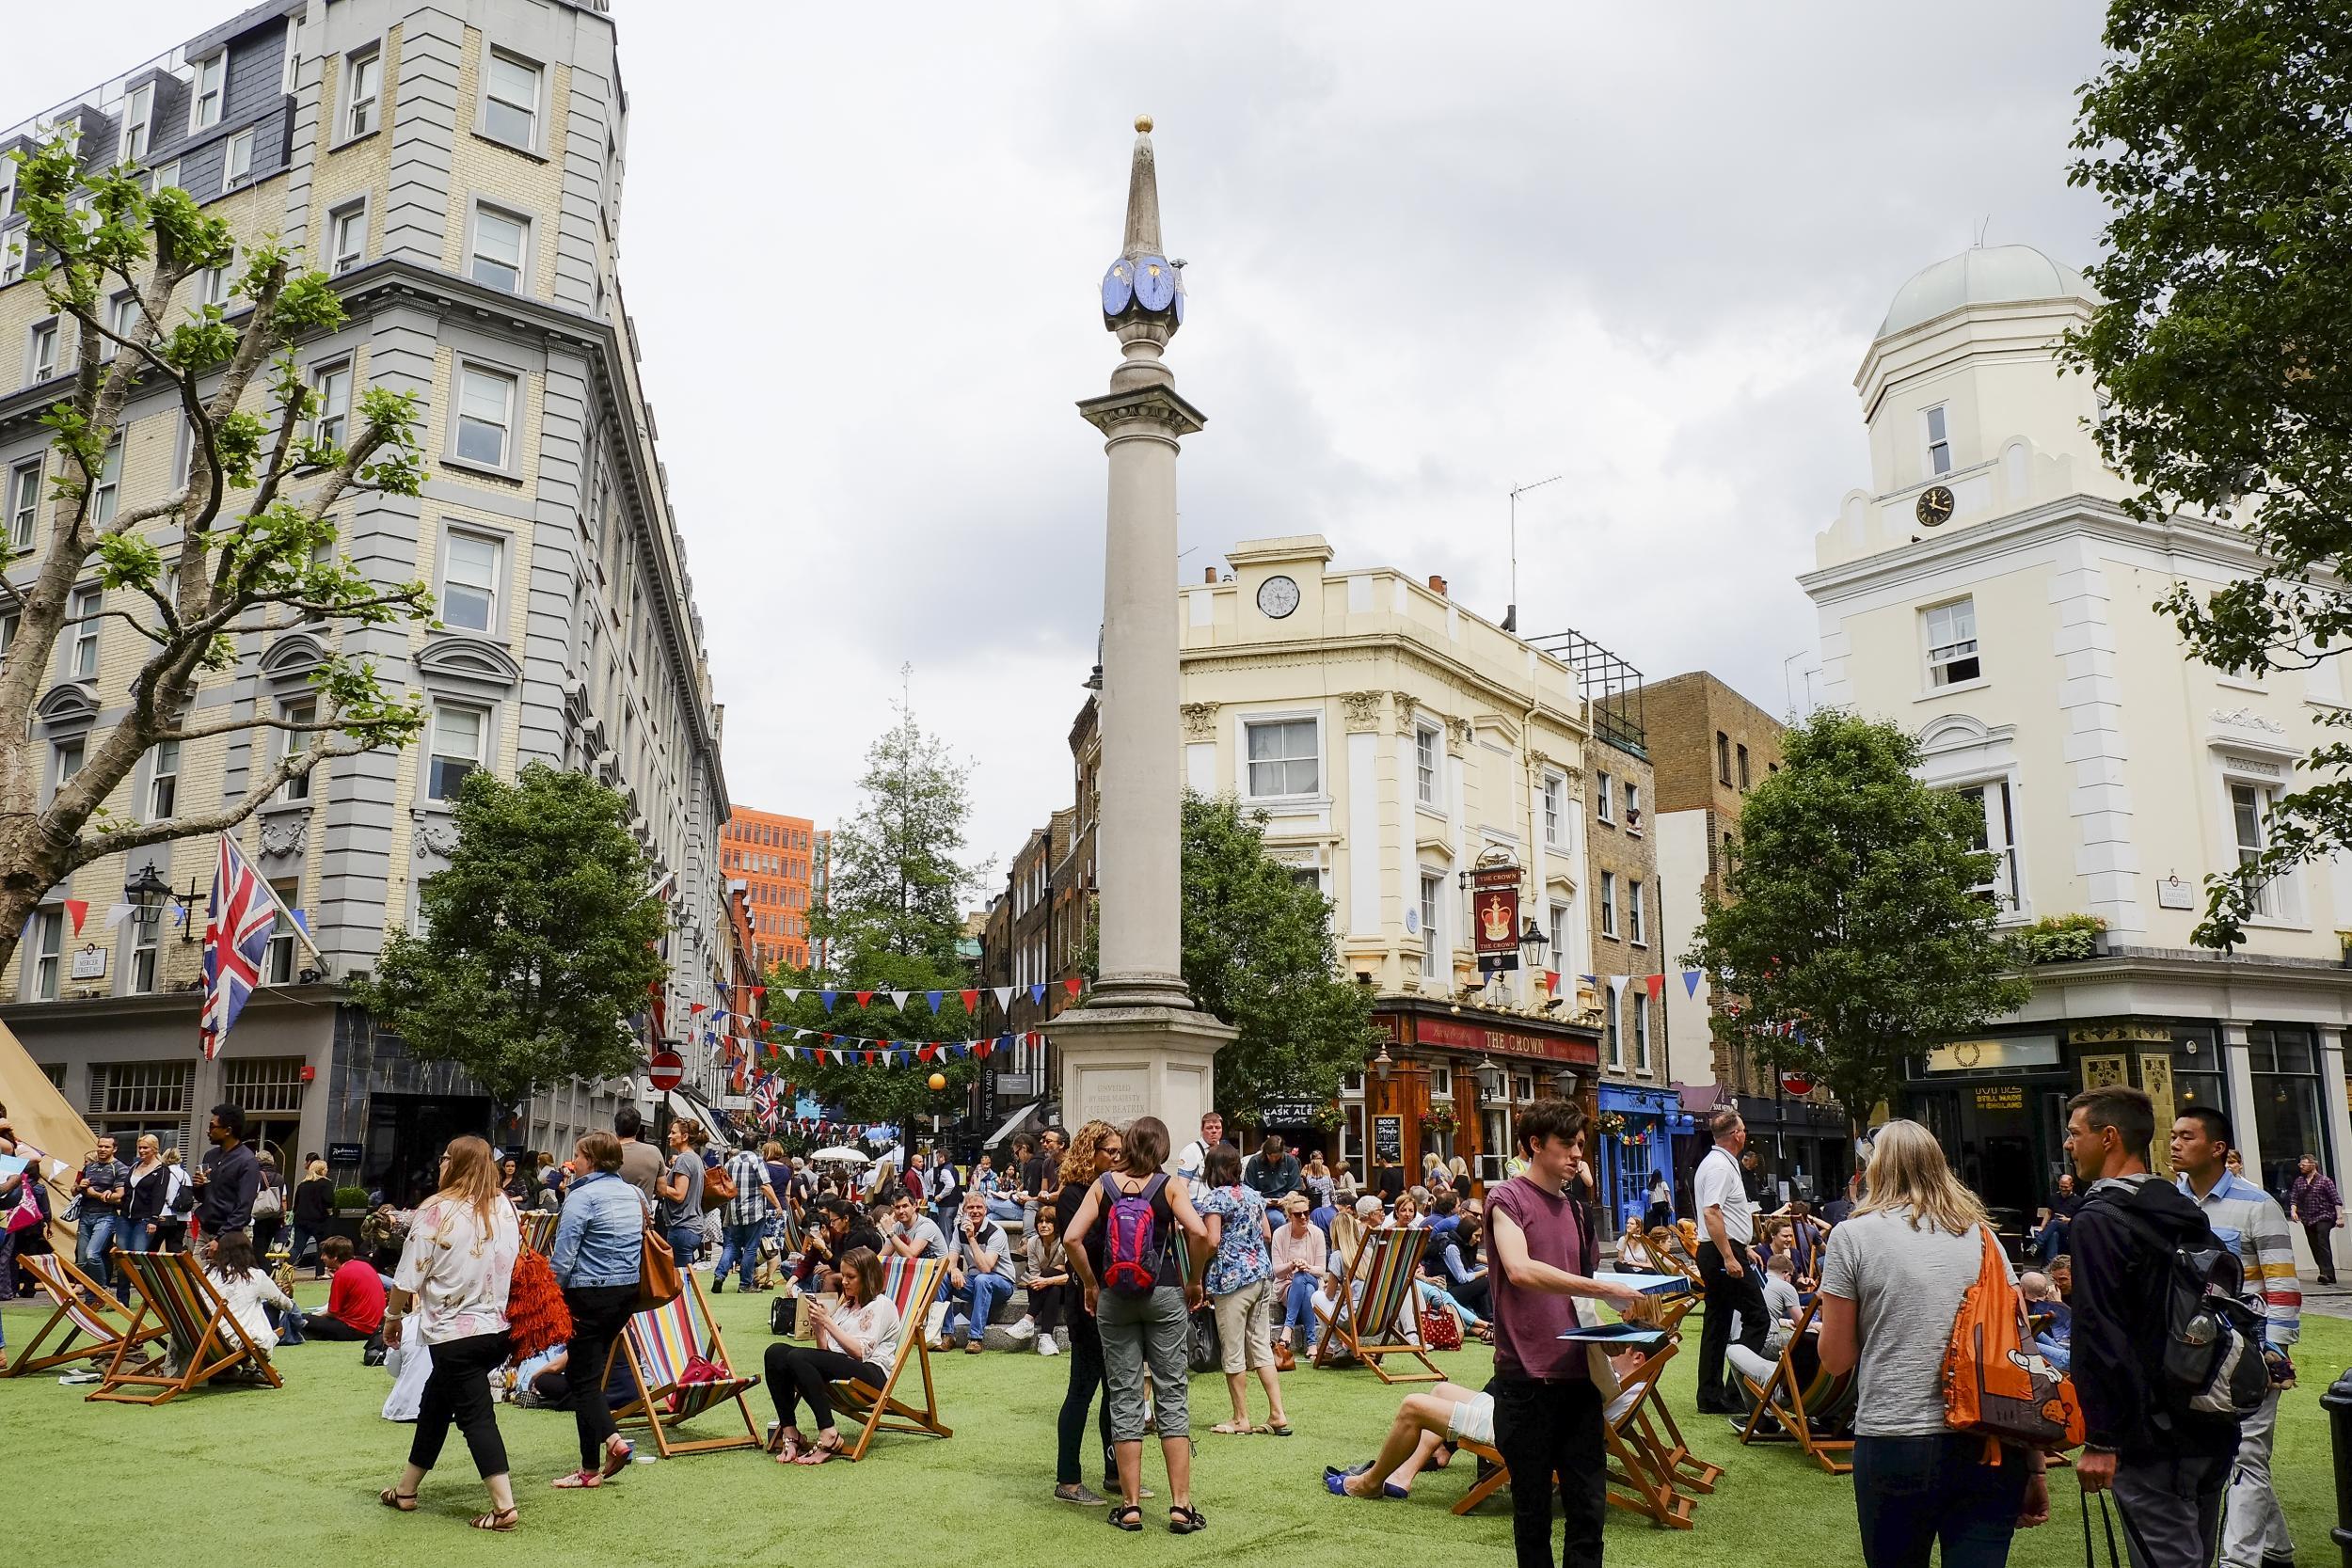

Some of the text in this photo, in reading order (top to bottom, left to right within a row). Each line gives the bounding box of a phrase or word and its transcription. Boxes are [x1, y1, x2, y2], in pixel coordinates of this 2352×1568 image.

[1493, 873, 1517, 881] CROWN
[1485, 1031, 1505, 1050] THE
[1509, 1035, 1545, 1054] CROWN
[985, 1069, 993, 1091] YARD
[1098, 1083, 1131, 1092] UNVEILED
[1112, 1093, 1140, 1101] MAJESTY
[1084, 1104, 1145, 1117] QUEEN BEATRIX
